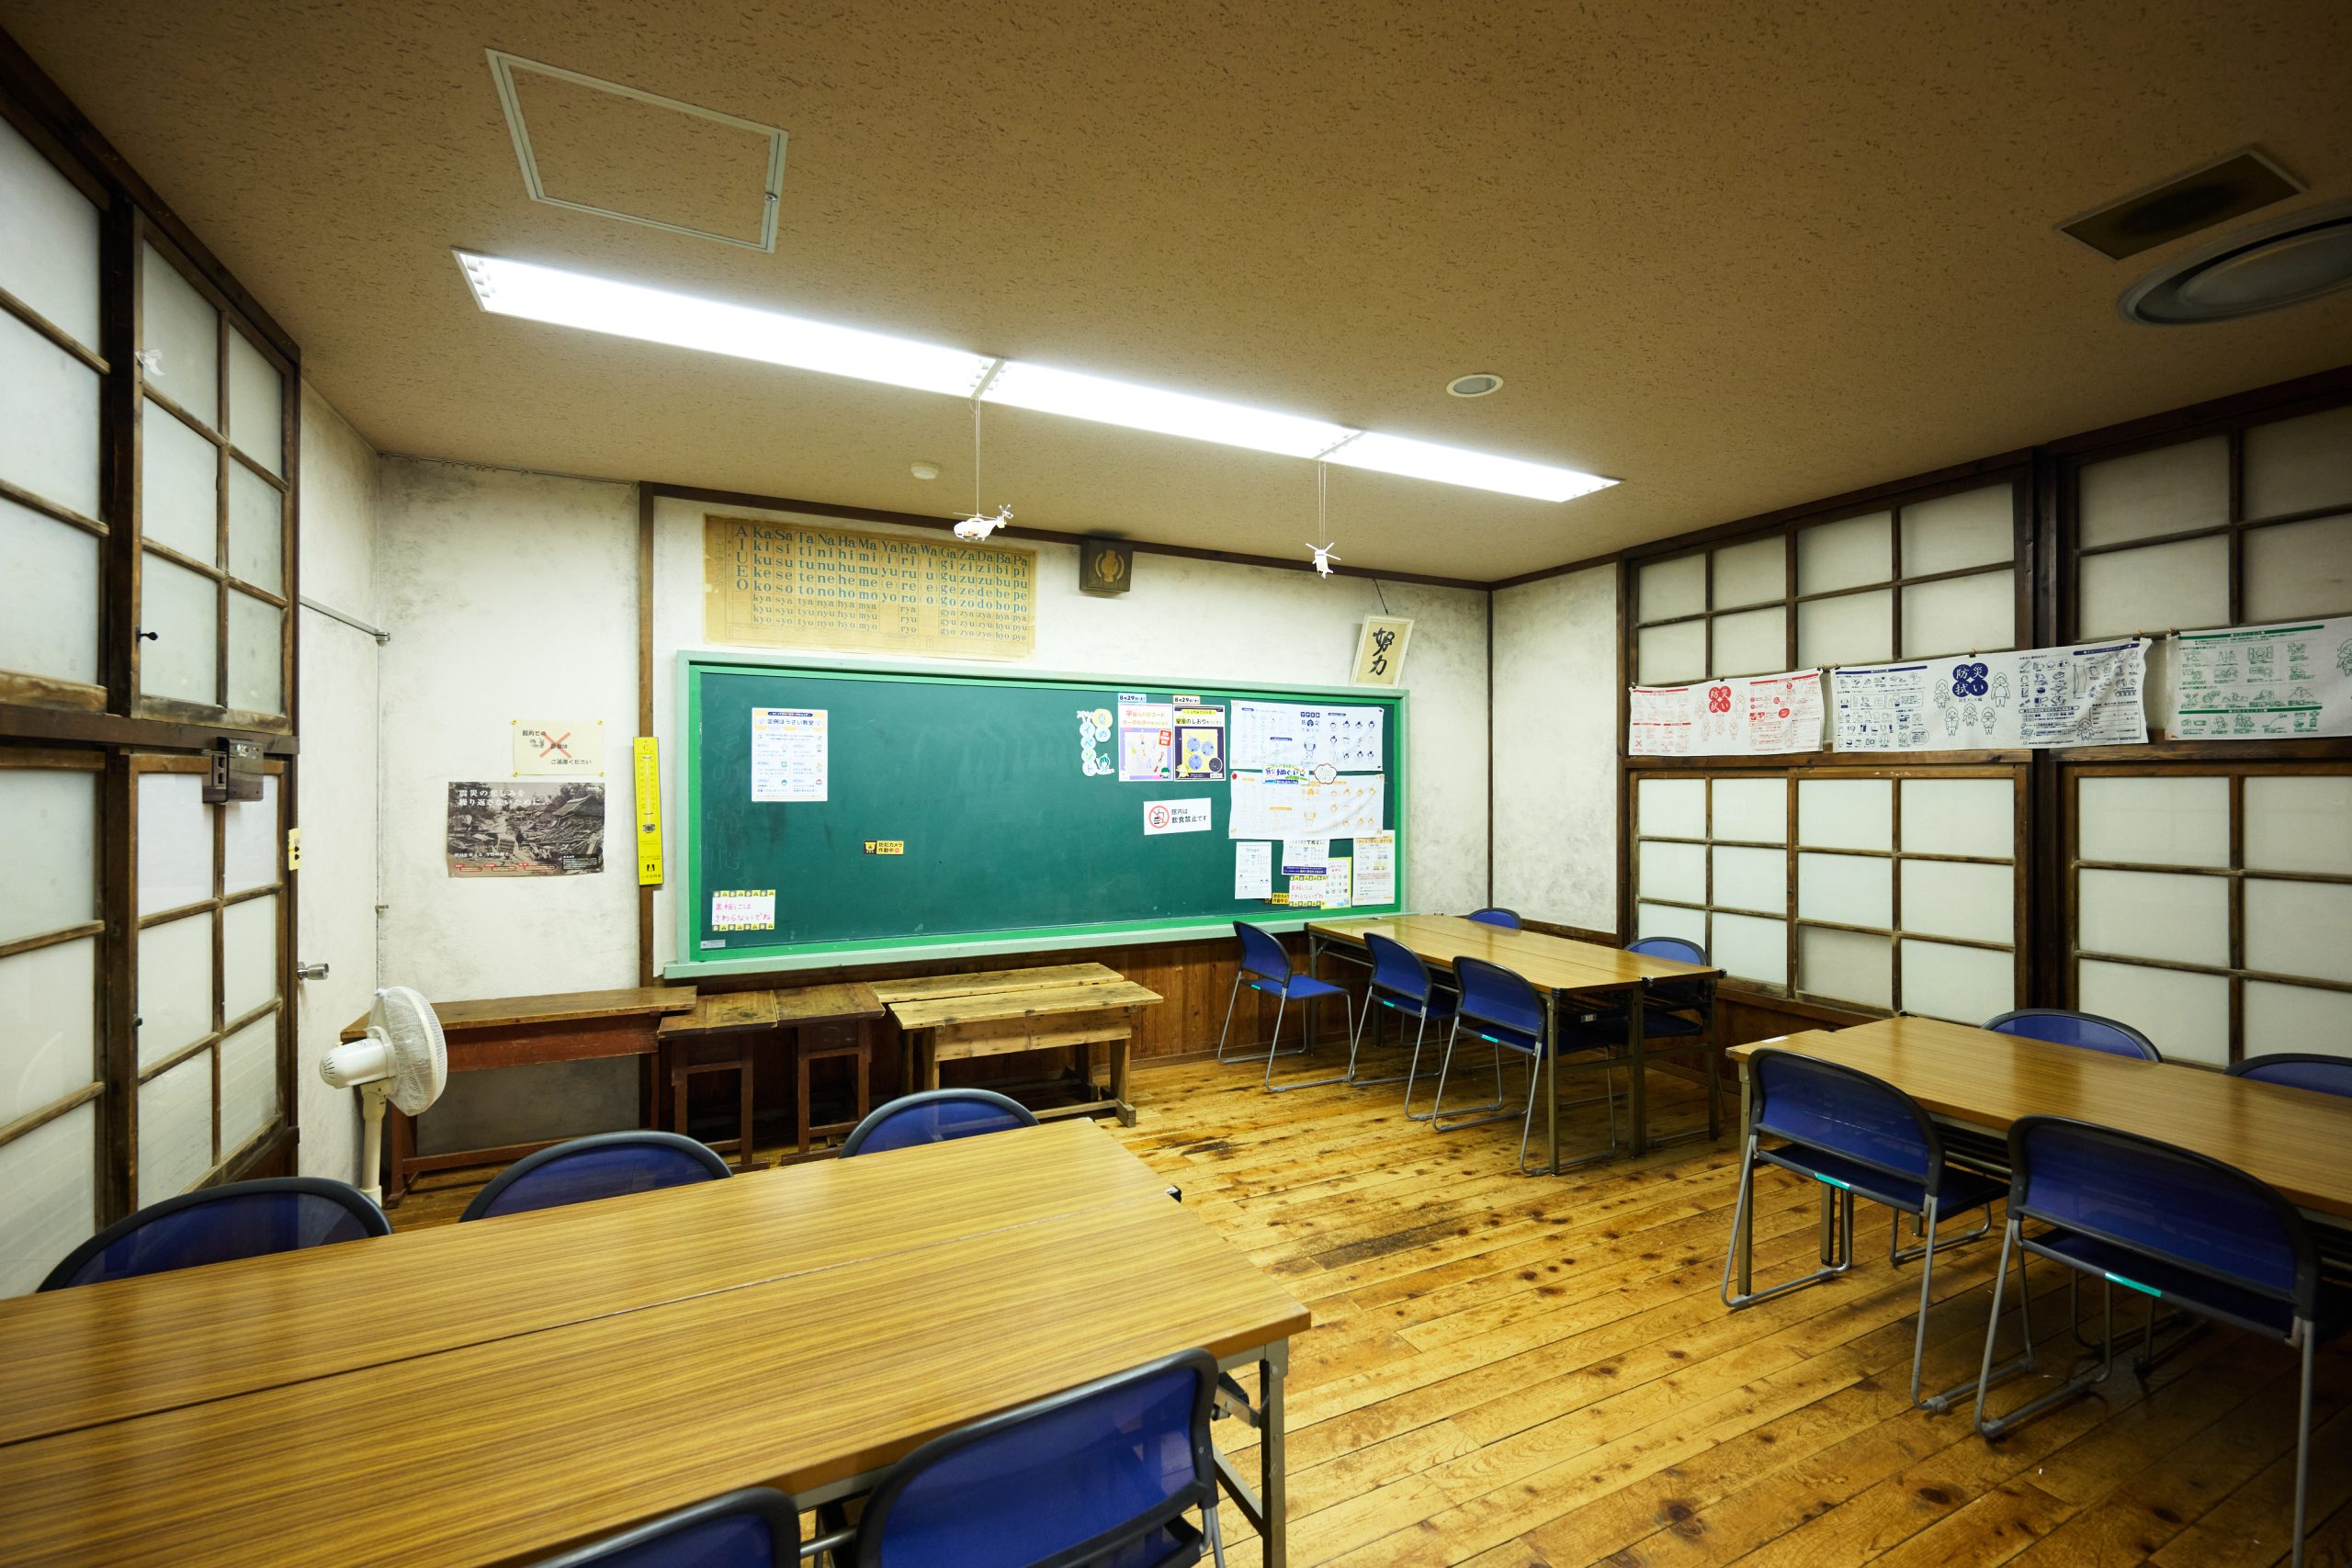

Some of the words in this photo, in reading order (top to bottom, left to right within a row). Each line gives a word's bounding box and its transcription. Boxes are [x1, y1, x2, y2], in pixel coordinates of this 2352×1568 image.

[736, 524, 747, 537] A
[753, 526, 771, 539] Ka
[775, 529, 793, 541] Sa
[818, 533, 834, 546] Na
[838, 535, 855, 548] Ha
[858, 537, 877, 550] Ma
[881, 540, 898, 552] Ya
[901, 543, 916, 554] Ra
[920, 545, 938, 556] Wa
[941, 547, 956, 559] Ga
[960, 548, 975, 561] Za
[978, 551, 993, 562] Da
[996, 553, 1011, 564] Ba
[1013, 554, 1027, 566] Pa
[741, 539, 743, 550] I
[753, 540, 769, 551] ki
[776, 544, 789, 554] si
[799, 546, 811, 556] ti
[818, 548, 832, 558] ni
[839, 549, 853, 559] hi
[859, 552, 875, 562] mi
[901, 556, 914, 566] ri
[941, 560, 953, 570] gi
[960, 562, 975, 572] zi
[978, 564, 993, 573] zi
[996, 564, 1011, 575] bi
[1013, 568, 1025, 578] pi
[737, 552, 748, 563] U
[754, 554, 771, 565] ku
[776, 559, 793, 567] su
[799, 560, 813, 569] tu
[818, 562, 834, 571] nu
[839, 561, 855, 573] hu
[859, 566, 877, 575] mu
[882, 567, 897, 577] yu
[941, 573, 956, 582] gu
[996, 576, 1011, 587] bu
[1014, 580, 1027, 589] pu
[737, 565, 748, 577] E
[754, 567, 771, 578] ke
[776, 572, 792, 580] se
[799, 572, 813, 582] te
[839, 574, 855, 585] he
[859, 579, 877, 587] me
[941, 586, 956, 595] ge
[978, 587, 992, 597] de
[996, 589, 1011, 598] be
[1014, 592, 1026, 601] pe
[737, 579, 748, 590] O
[754, 580, 771, 591] ko
[776, 585, 793, 593] so
[799, 585, 813, 594] to
[839, 587, 855, 598] ho
[882, 593, 897, 602] yo
[941, 597, 956, 606] go
[978, 599, 992, 609] do
[996, 601, 1011, 610] bo
[1013, 604, 1027, 613] po
[1368, 627, 1395, 676] 努力
[1955, 683, 1984, 695] 拭い
[1956, 666, 1984, 679] 防災
[1710, 689, 1730, 699] 防災
